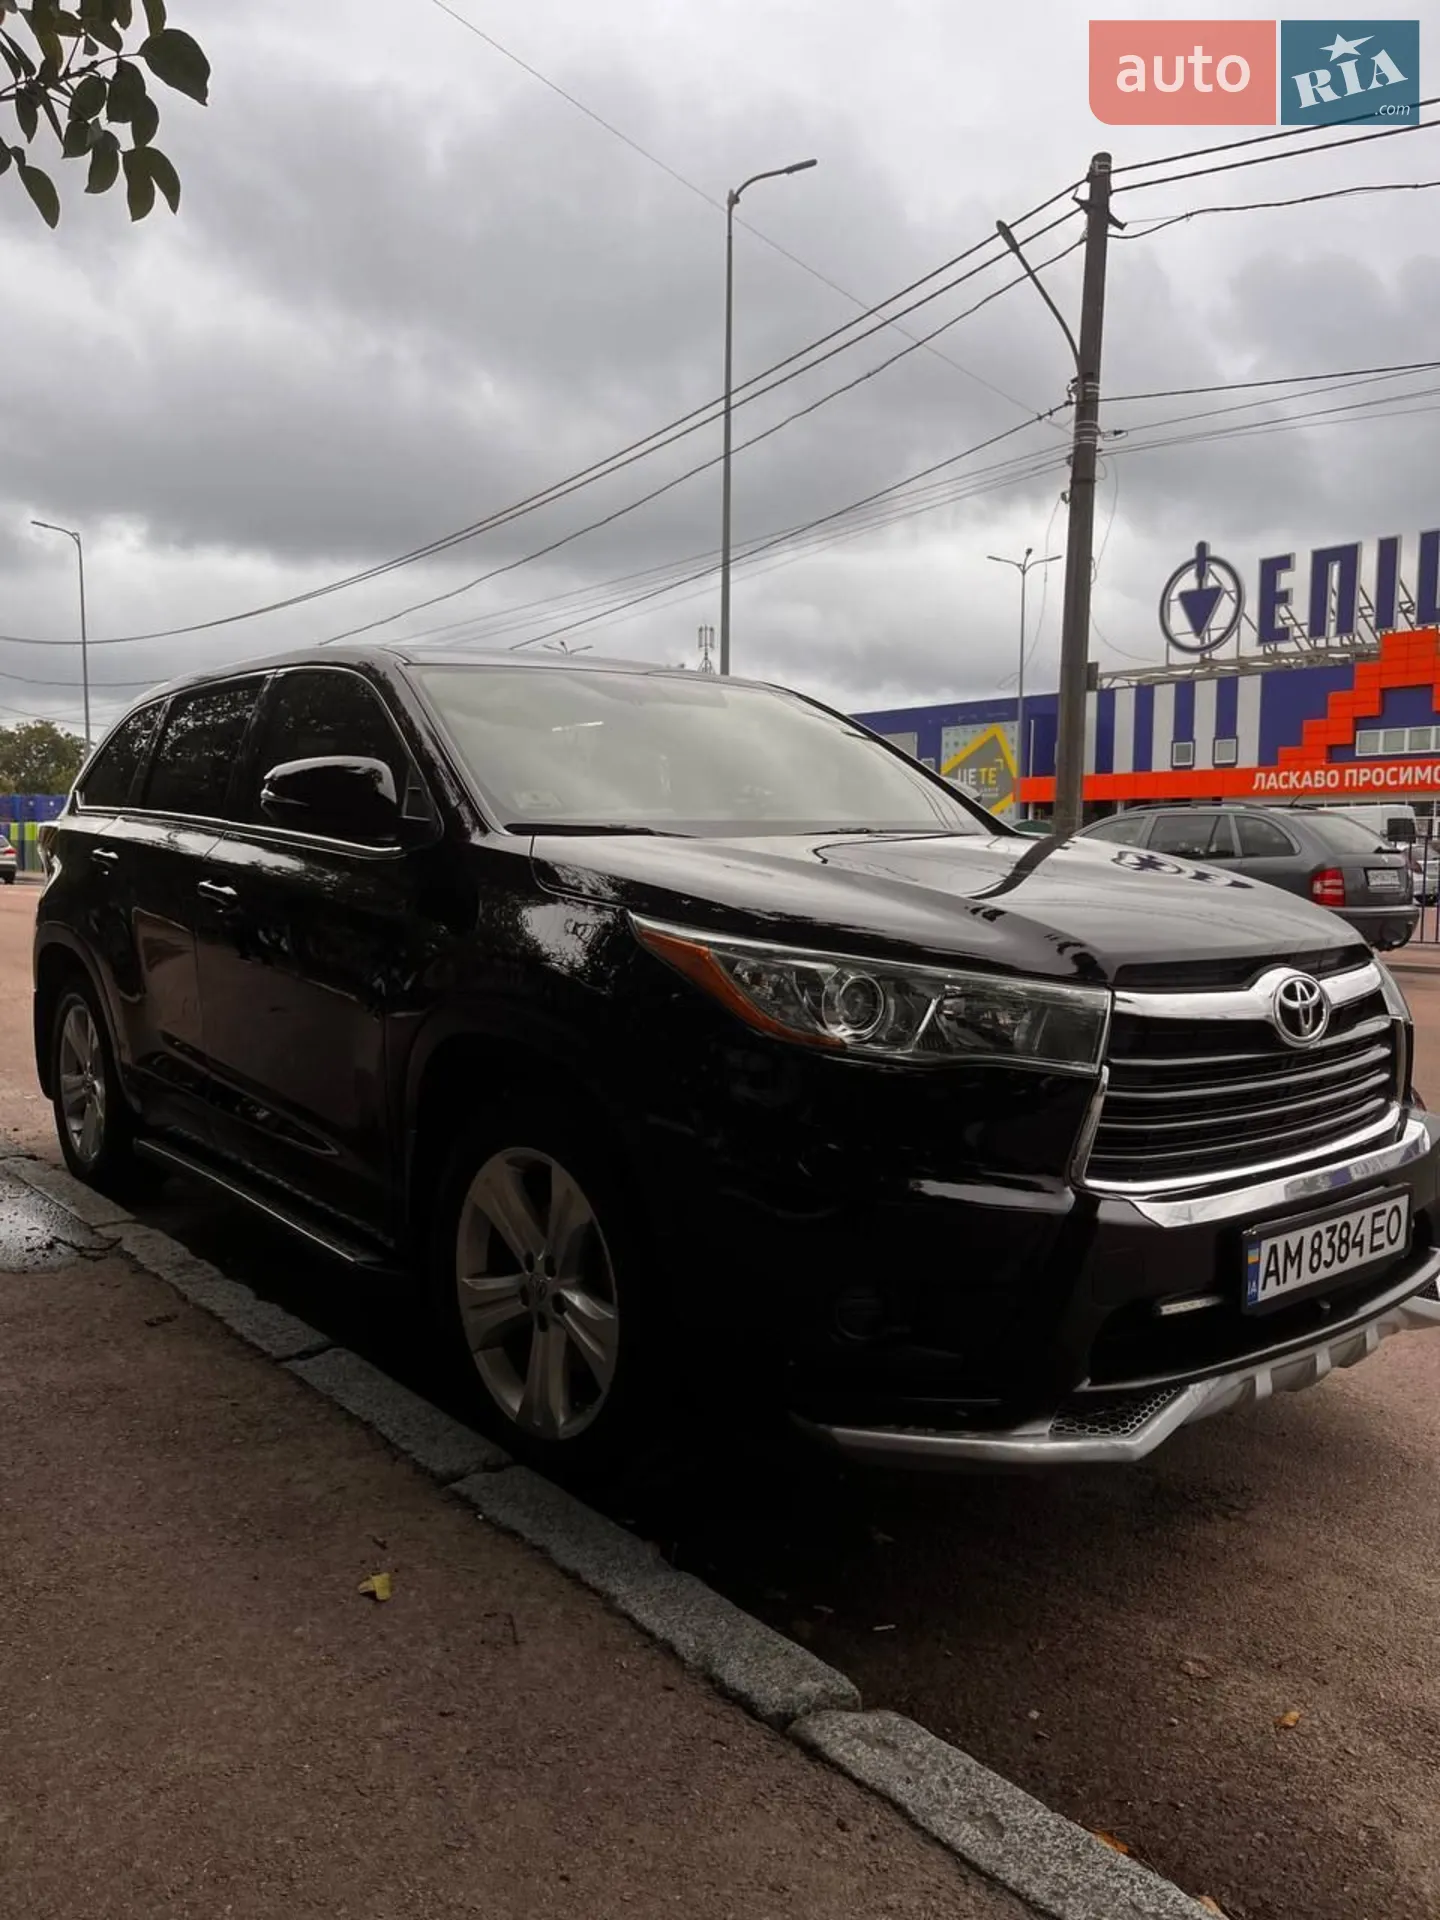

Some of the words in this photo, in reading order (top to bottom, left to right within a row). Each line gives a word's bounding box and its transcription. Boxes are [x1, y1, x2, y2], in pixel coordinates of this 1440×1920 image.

[1252, 769, 1340, 791] ЛАСКАВО
[1261, 1235, 1304, 1291] AM
[1308, 1215, 1366, 1274] 8384
